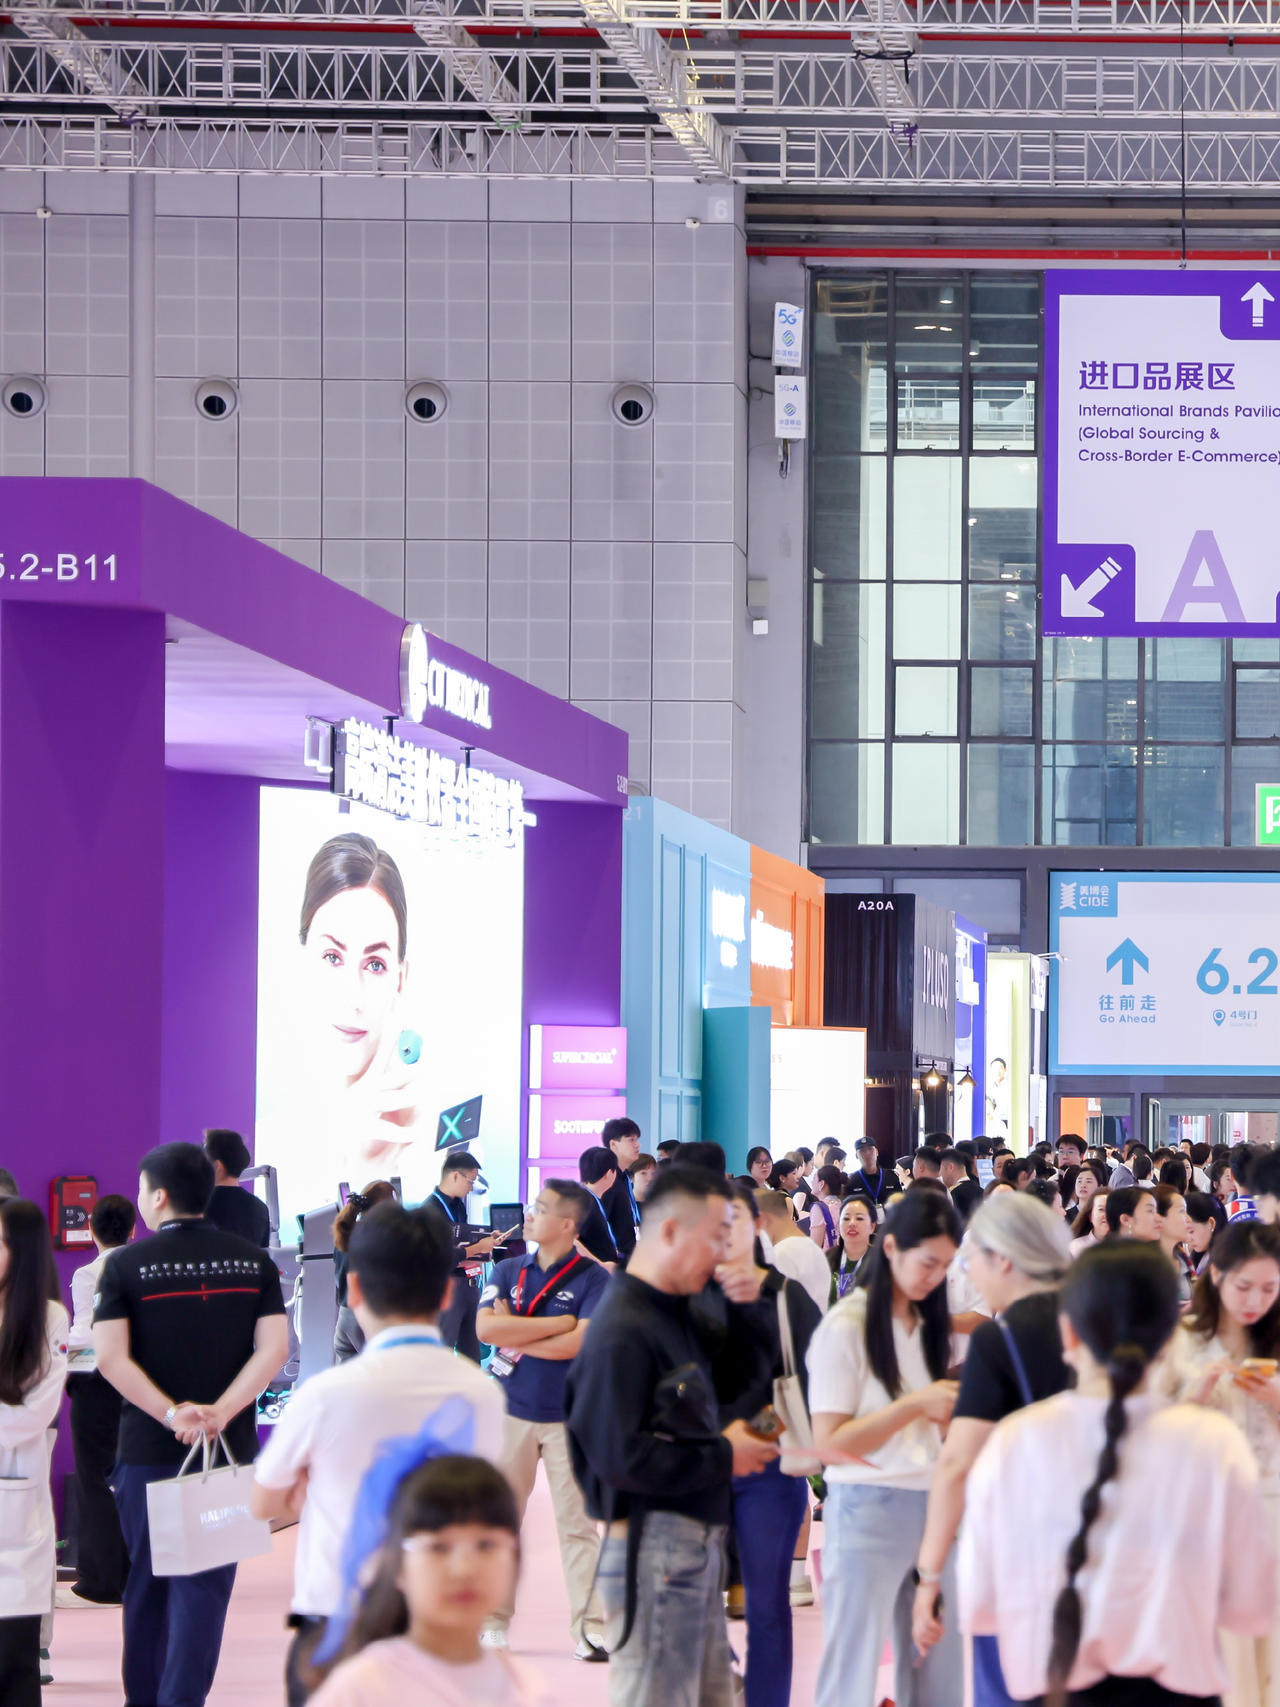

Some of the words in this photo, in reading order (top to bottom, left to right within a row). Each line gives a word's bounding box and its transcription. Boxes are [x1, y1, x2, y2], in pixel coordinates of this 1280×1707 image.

[1078, 361, 1236, 392] 进口品展区
[779, 384, 799, 392] 5G-A
[1078, 404, 1173, 418] International
[1179, 404, 1229, 418] Brands
[1078, 427, 1134, 442] (Global
[1139, 427, 1204, 442] Sourcing
[1210, 428, 1220, 440] &
[1078, 450, 1172, 463] Cross-Border
[1160, 530, 1246, 622] A
[1080, 886, 1109, 896] 美博会
[858, 900, 894, 911] A20A
[1080, 896, 1108, 906] CIBE
[1196, 948, 1278, 994] 6.2
[1098, 995, 1156, 1011] 往前走
[1099, 1014, 1114, 1024] Go
[1119, 1014, 1156, 1024] Ahead
[1230, 1010, 1258, 1020] 4号门
